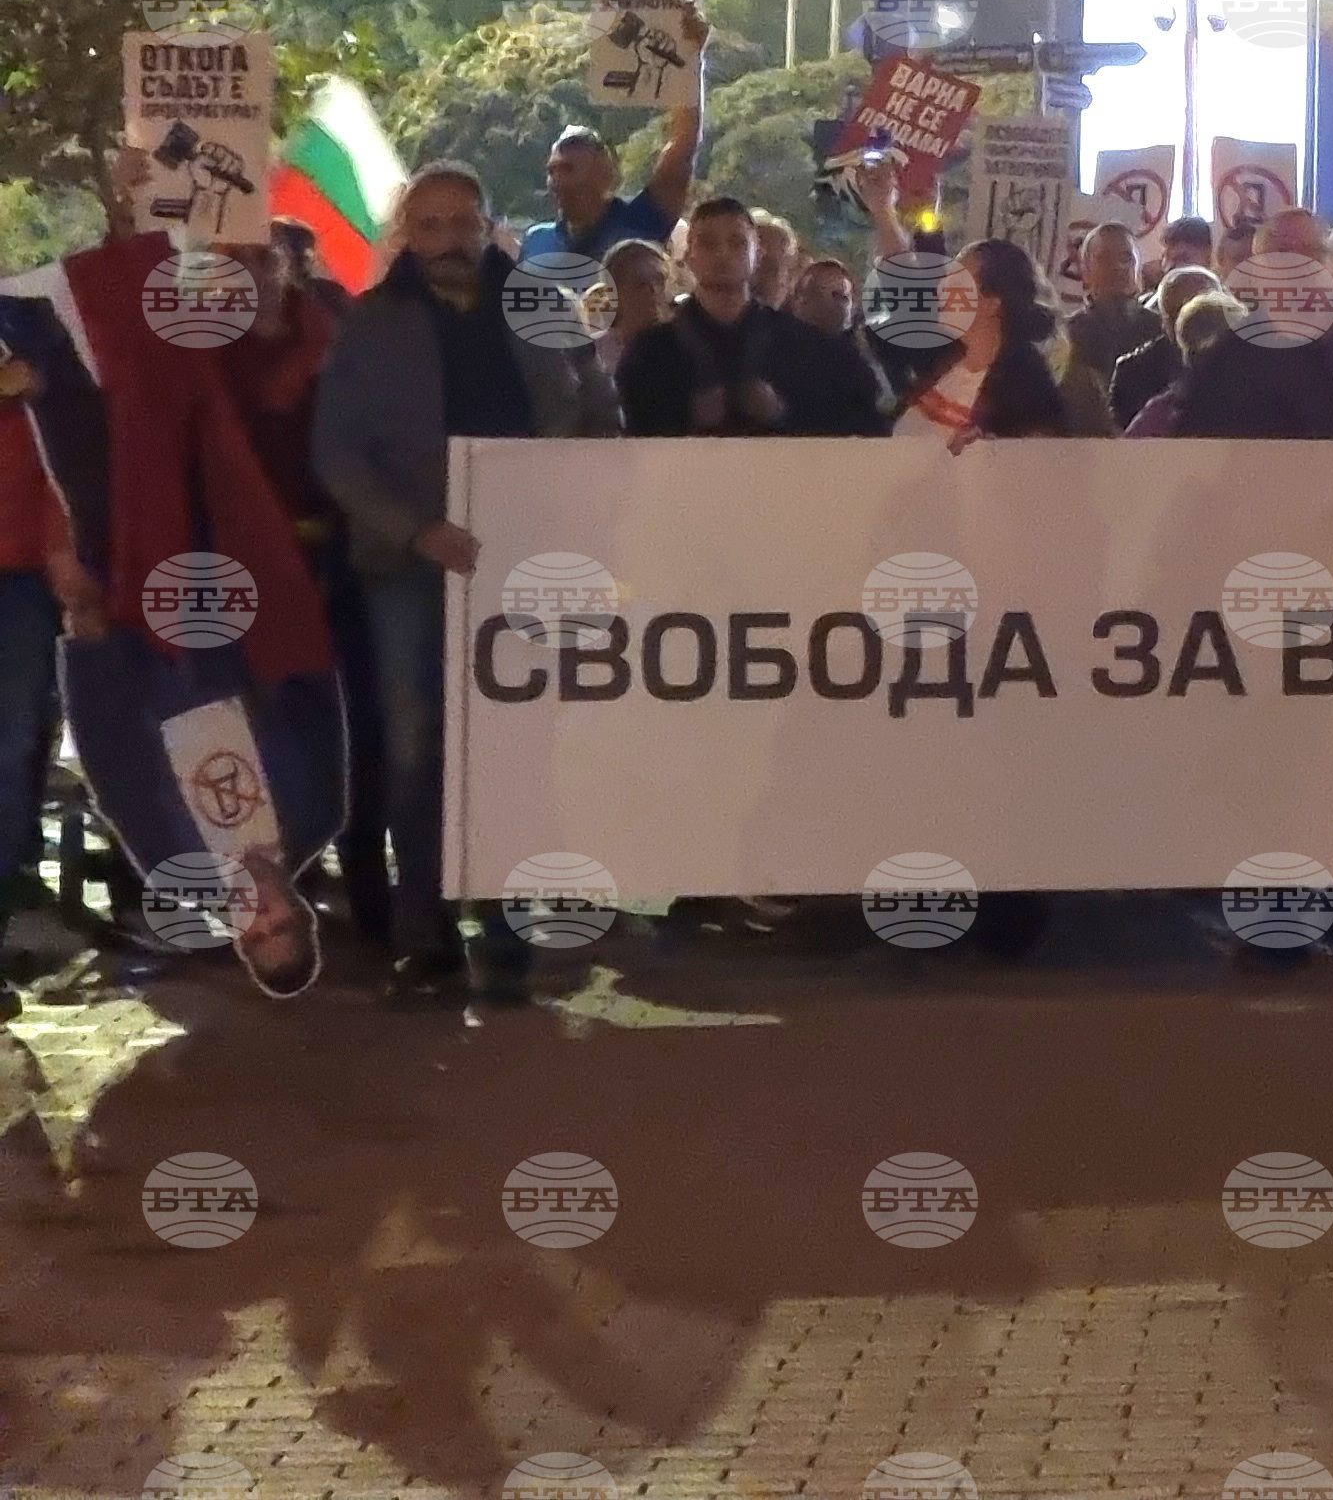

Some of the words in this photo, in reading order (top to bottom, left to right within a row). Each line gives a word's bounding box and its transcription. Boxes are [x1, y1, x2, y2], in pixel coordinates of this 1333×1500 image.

[140, 44, 248, 72] ОТКОГА
[141, 75, 223, 99] СЪДЪТ
[230, 76, 244, 100] Е
[889, 63, 968, 113] ВАРНА
[885, 91, 919, 122] НЕ
[918, 105, 948, 133] СЕ
[473, 610, 1059, 719] СВОБОДА
[1090, 609, 1246, 699] ЗА
